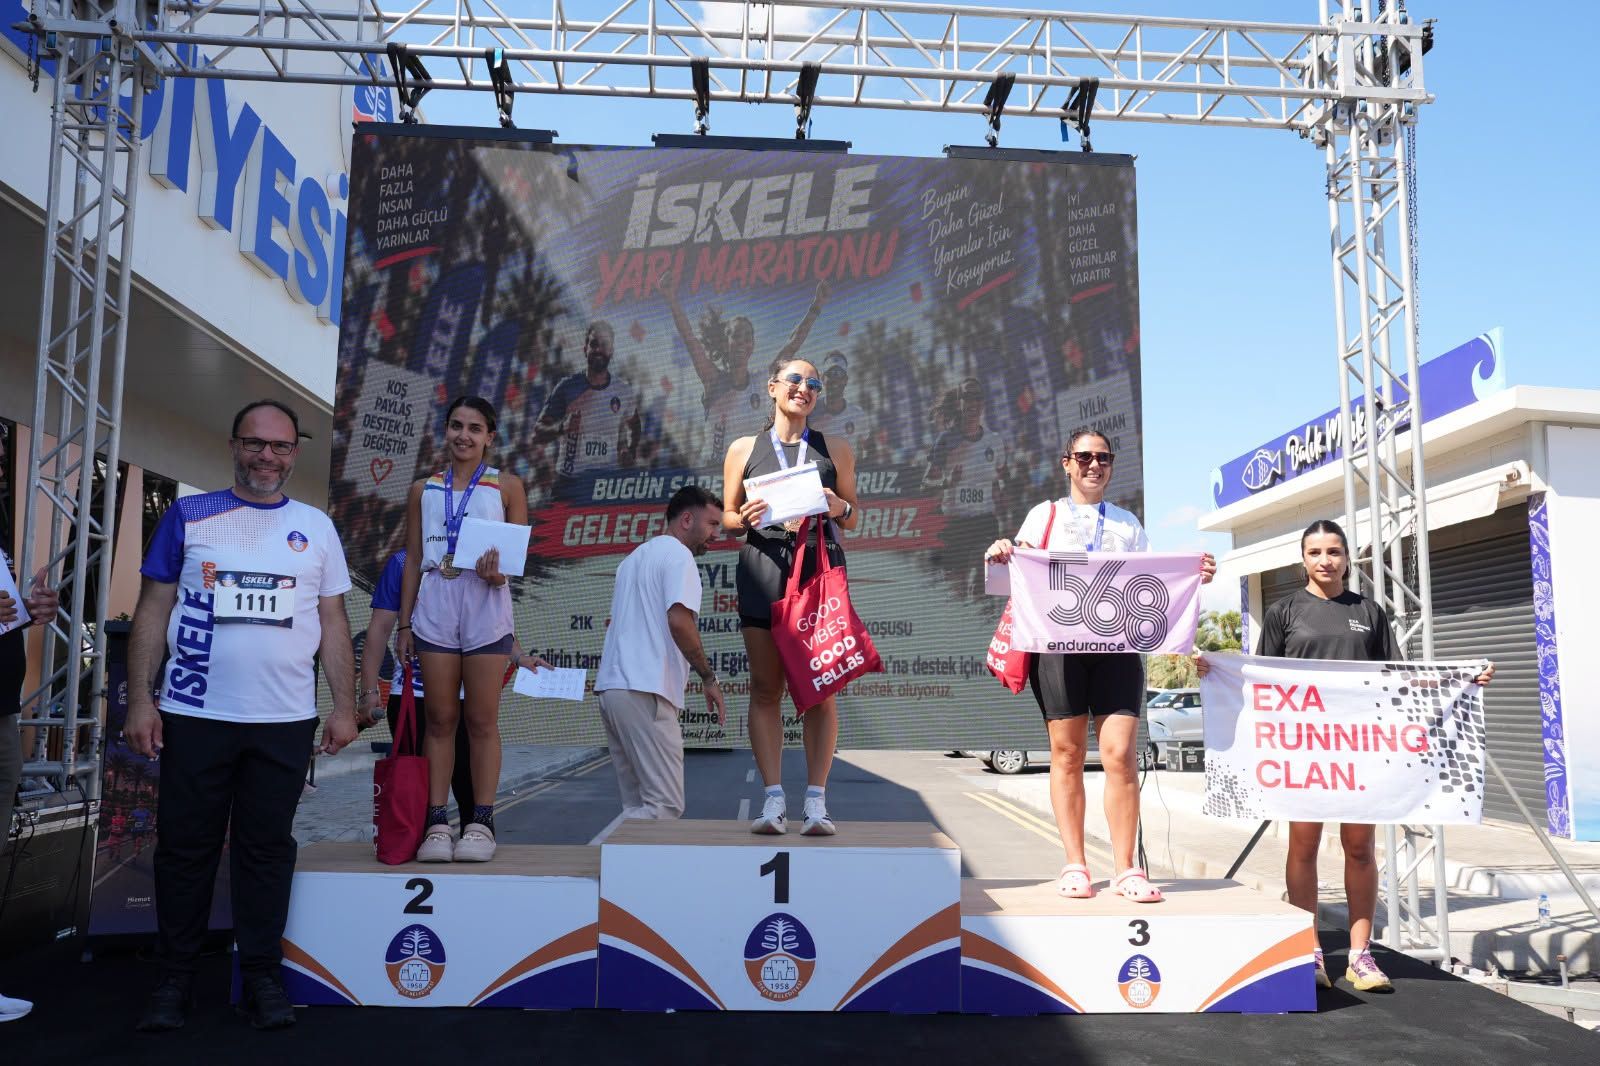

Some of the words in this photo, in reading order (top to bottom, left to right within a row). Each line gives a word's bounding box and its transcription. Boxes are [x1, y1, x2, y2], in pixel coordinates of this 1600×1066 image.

[381, 163, 413, 181] DAHA
[380, 181, 413, 197] FAZLA
[378, 198, 412, 215] İNSAN
[622, 163, 880, 250] İSKELE
[921, 184, 970, 220] Bugün
[377, 214, 408, 233] DAHA
[411, 207, 448, 228] GÜÇLÜ
[928, 214, 963, 247] Daha
[968, 192, 1004, 227] Güzel
[1068, 223, 1096, 238] DAHA
[376, 229, 429, 250] YARINLAR
[934, 232, 984, 277] Yarınlar
[987, 223, 1013, 249] İçin
[1069, 238, 1100, 253] GÜZEL
[592, 247, 685, 309] YARI
[690, 229, 899, 295] MARATONU
[1069, 251, 1117, 270] YARINLAR
[1070, 268, 1111, 287] YARATIR
[386, 380, 408, 400] KOŞ
[374, 396, 413, 420] PAYLAŞ
[362, 413, 402, 434] DESTEK
[402, 422, 415, 438] OL
[362, 433, 408, 456] DEĞİŞTİR
[585, 441, 608, 456] 0718
[592, 471, 664, 500] BUGÜN
[856, 471, 901, 494] RUZ.
[562, 511, 668, 547] GELECE
[235, 593, 277, 613] 1111
[797, 596, 841, 632] GOOD
[1047, 552, 1169, 652] 568
[570, 615, 593, 630] 21K
[698, 617, 733, 632] HALK
[803, 616, 848, 651] VIBES
[167, 587, 215, 709] İSKELE
[810, 635, 857, 671] GOOD
[1047, 640, 1126, 652] endurance
[912, 655, 959, 675] destek
[852, 681, 894, 697] destek
[897, 683, 954, 700] oluyoruz.
[1252, 684, 1326, 712] EXA
[678, 708, 719, 724] Hizme
[1255, 722, 1430, 753] RUNNING
[1255, 759, 1367, 791] CLAN.
[760, 852, 790, 904] 1
[403, 878, 434, 915] 2
[1128, 919, 1151, 947] 3
